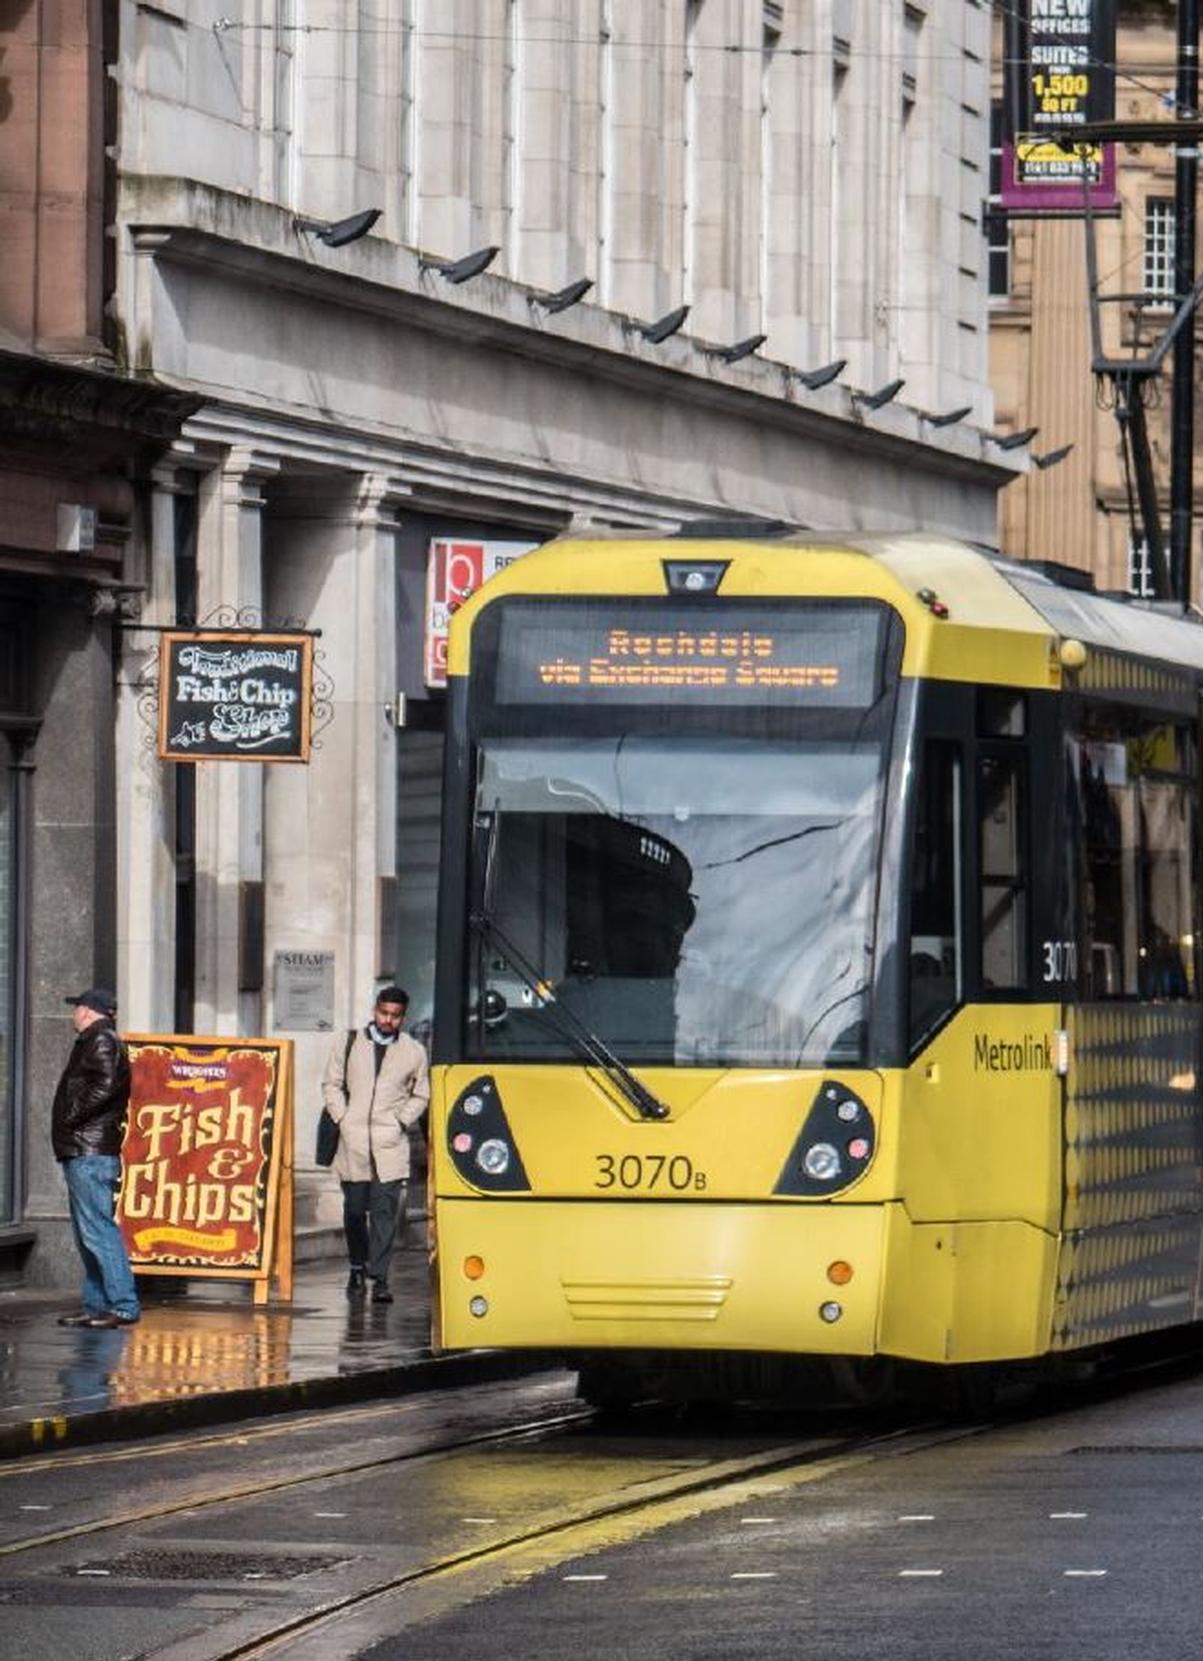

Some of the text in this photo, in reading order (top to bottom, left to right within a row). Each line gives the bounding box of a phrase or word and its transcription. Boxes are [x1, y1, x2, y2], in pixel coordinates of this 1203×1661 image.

[1031, 0, 1090, 17] NEW
[1031, 18, 1091, 34] OFFICES
[1031, 45, 1089, 64] SUITES
[1032, 74, 1088, 97] 1,500
[974, 1032, 1053, 1072] Metrolink
[136, 1086, 255, 1162] Fish
[207, 1148, 254, 1180] &
[123, 1159, 257, 1228] Chips
